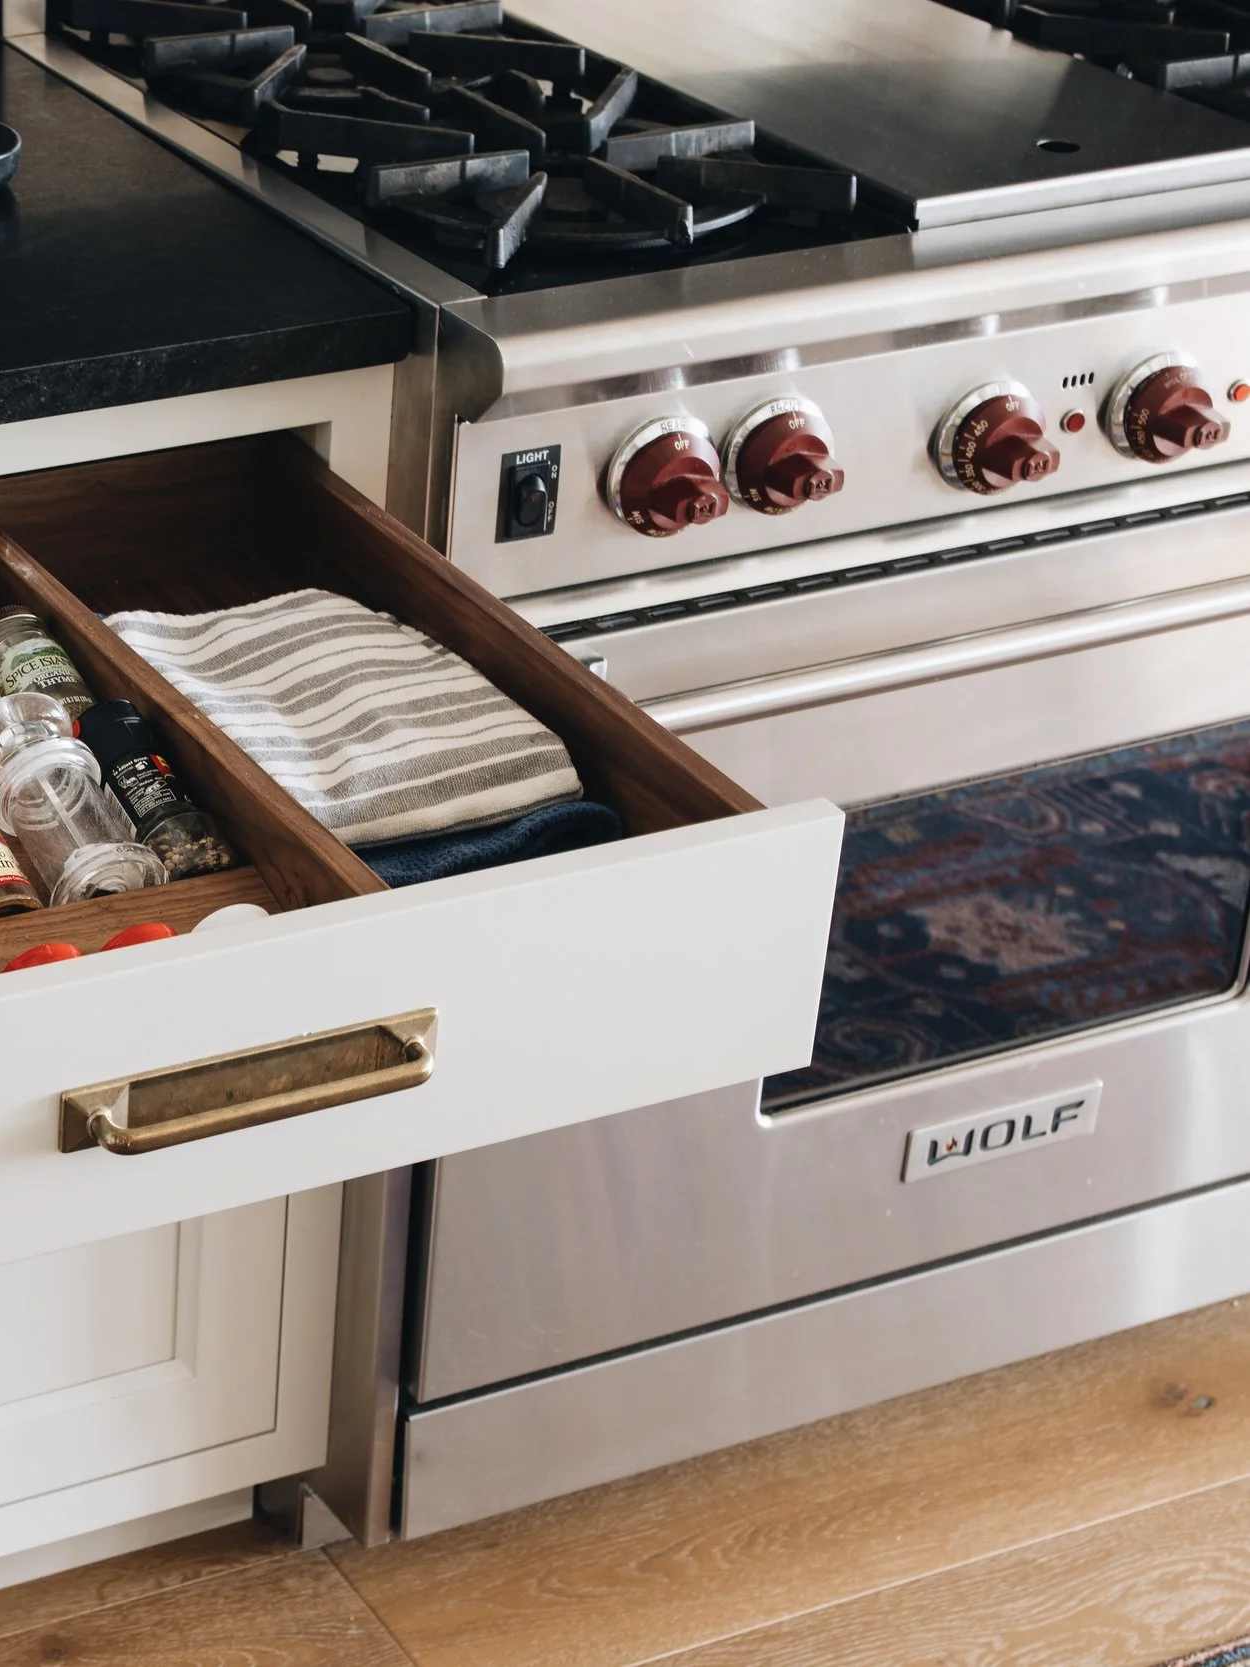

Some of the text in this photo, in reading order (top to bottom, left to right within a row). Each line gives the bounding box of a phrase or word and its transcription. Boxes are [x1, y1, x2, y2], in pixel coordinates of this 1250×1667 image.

[1006, 401, 1020, 411] OFF
[660, 421, 687, 432] REAR
[788, 418, 805, 430] OFF
[974, 420, 988, 437] 450
[674, 440, 690, 451] OFF
[965, 441, 976, 458] 400
[516, 450, 549, 465] LIGHT
[551, 464, 557, 479] ON
[631, 511, 645, 525] SIM
[5, 660, 40, 688] SPICE
[37, 676, 77, 689] THYME
[926, 1099, 1085, 1167] WOLF
